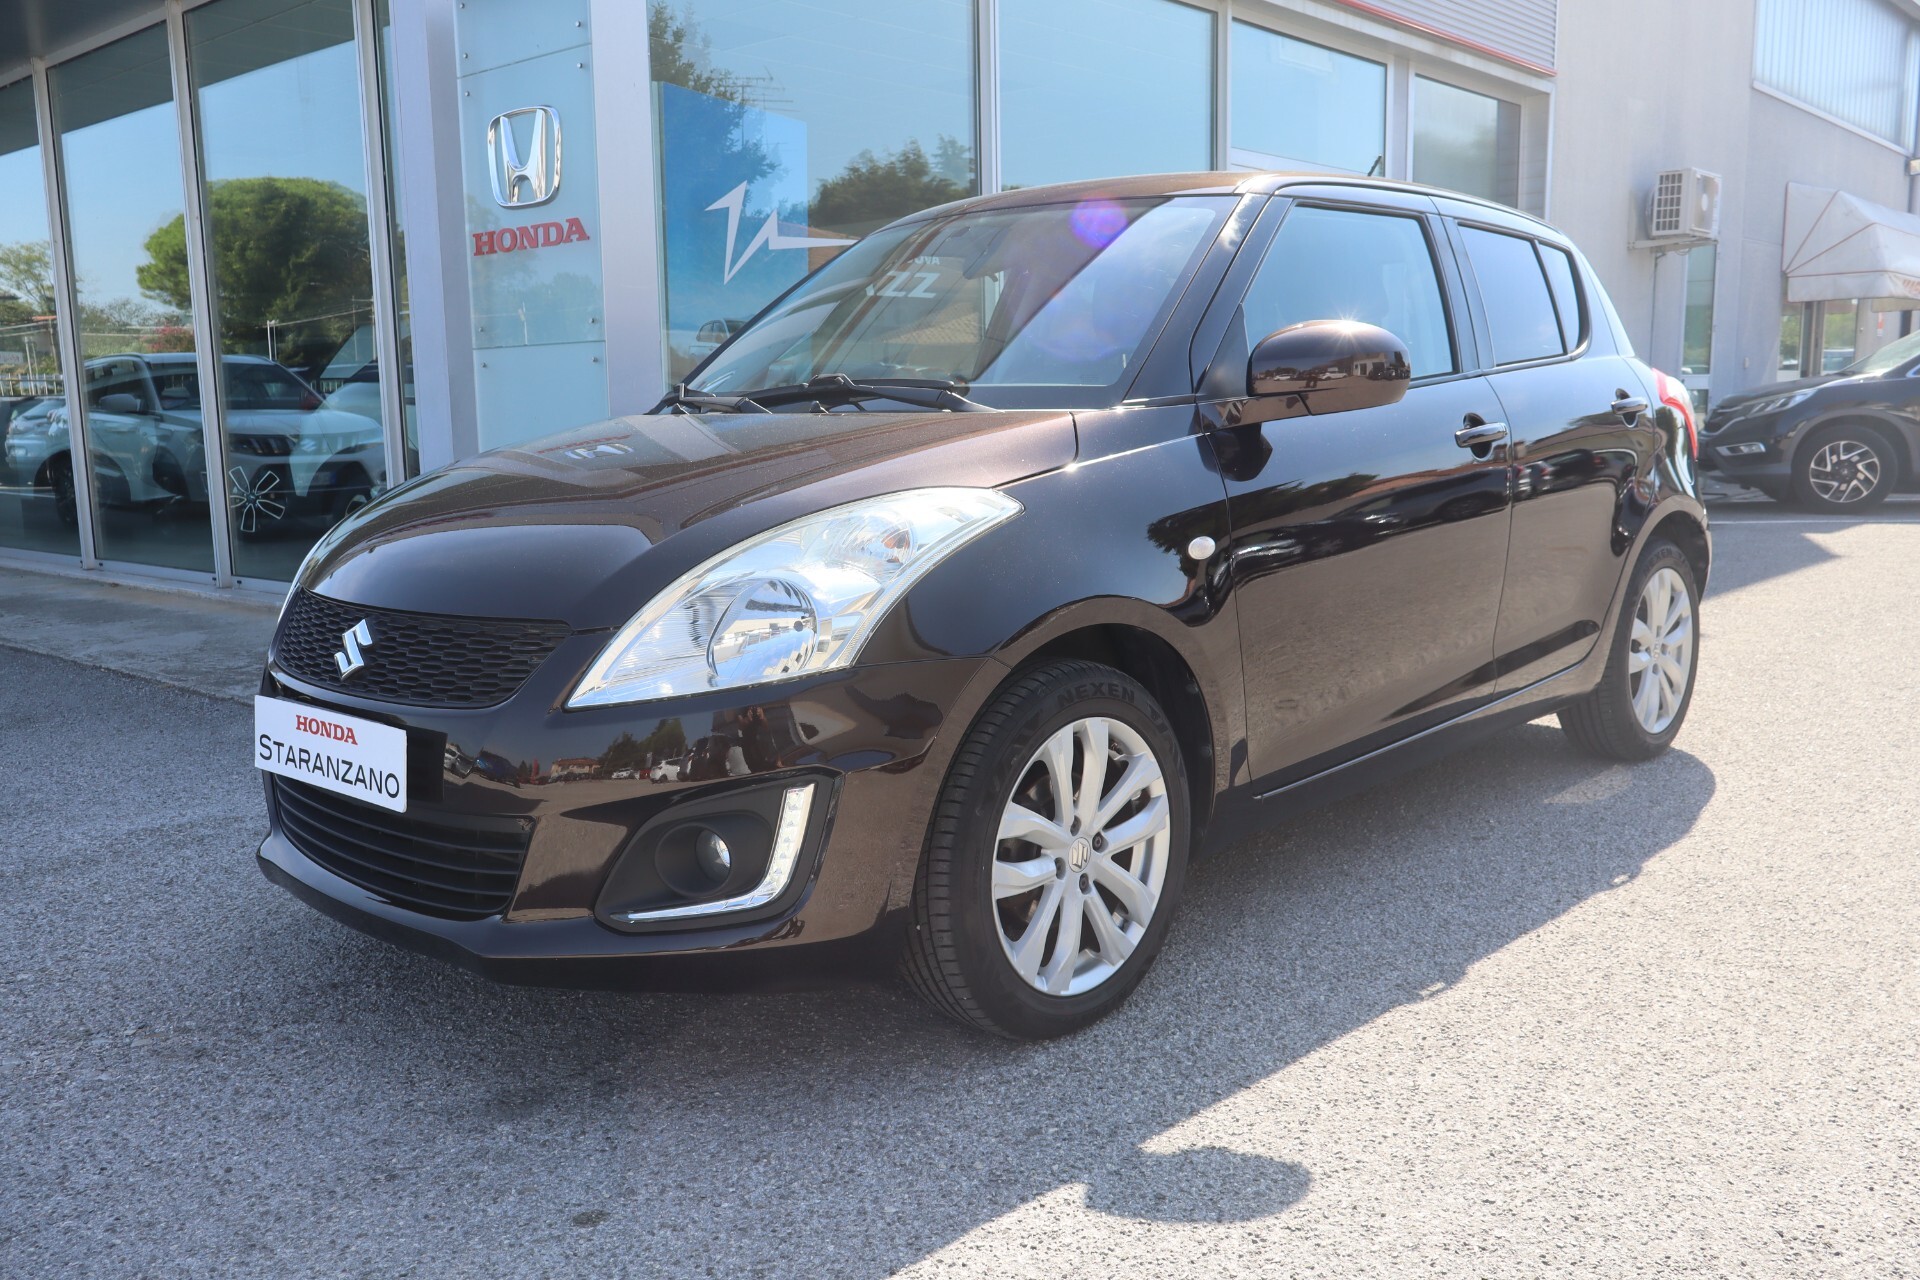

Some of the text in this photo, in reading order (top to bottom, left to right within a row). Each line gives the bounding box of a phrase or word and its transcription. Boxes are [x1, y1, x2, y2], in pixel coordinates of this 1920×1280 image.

[472, 217, 590, 256] HONDA
[1057, 682, 1136, 705] NEXEN
[295, 715, 358, 745] HONDA
[259, 734, 400, 799] STARANZANO
